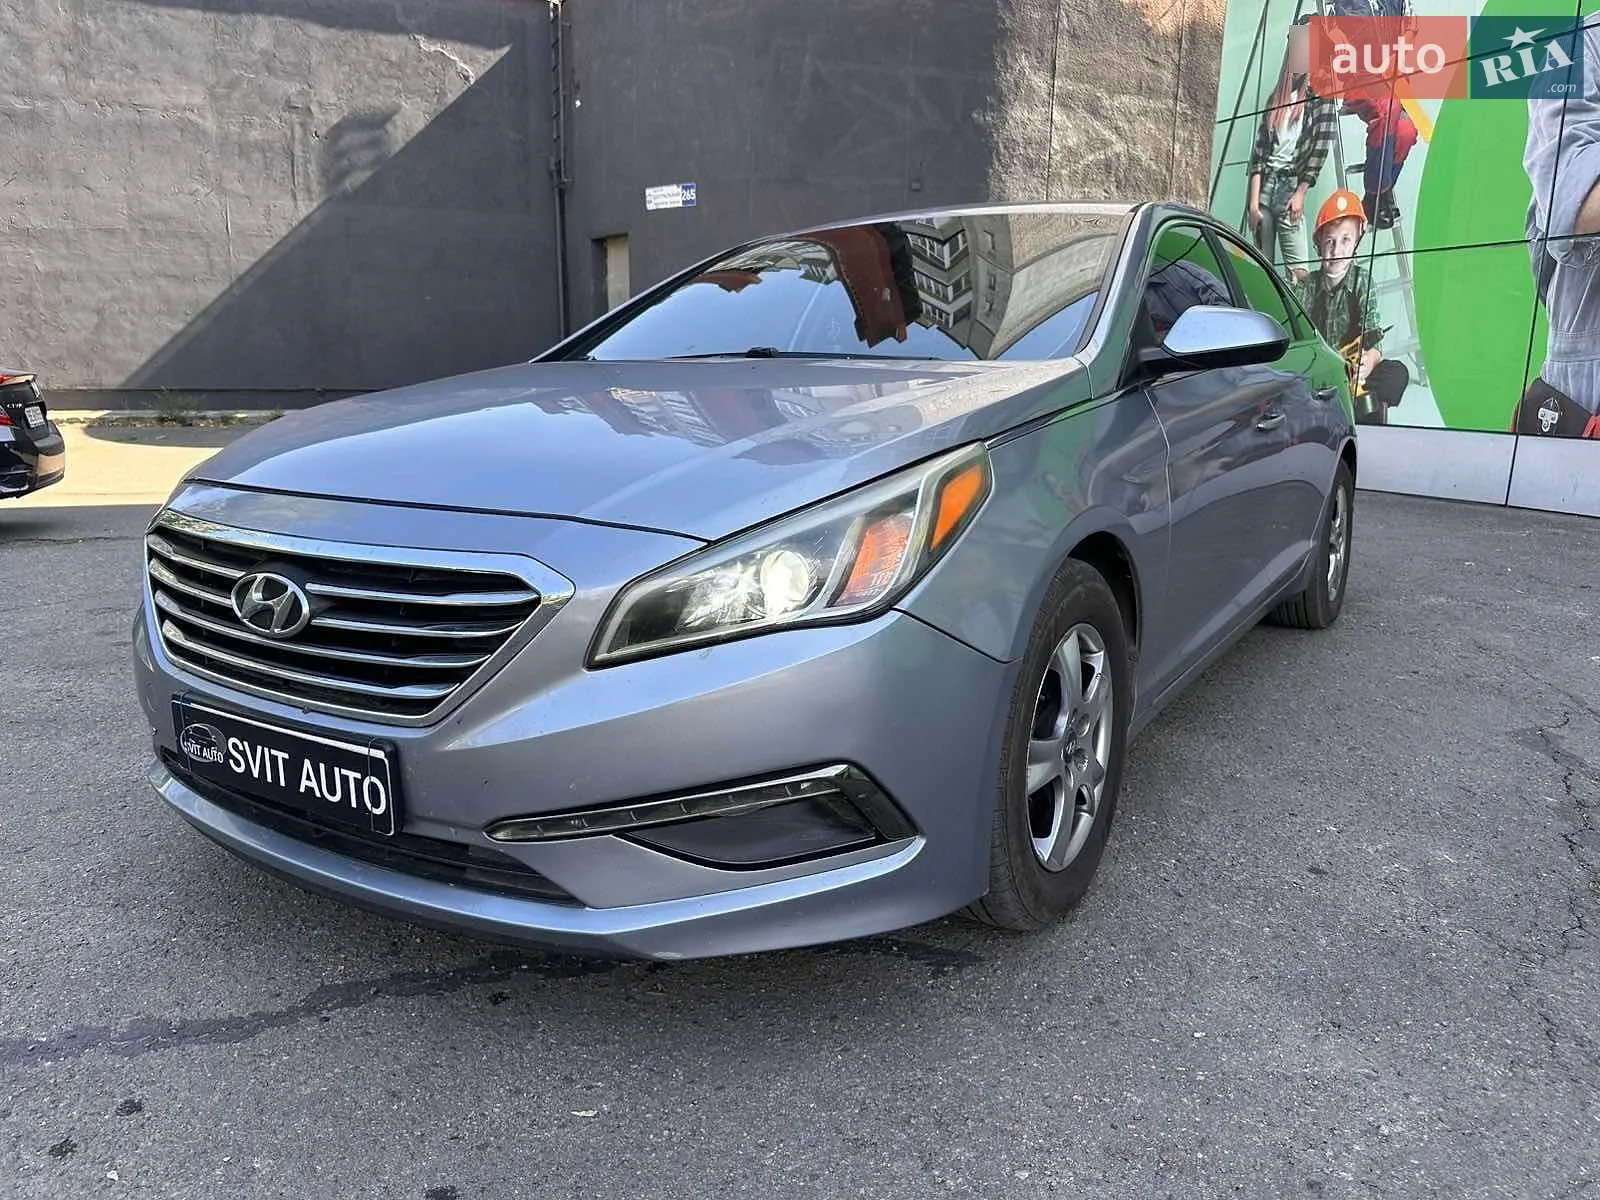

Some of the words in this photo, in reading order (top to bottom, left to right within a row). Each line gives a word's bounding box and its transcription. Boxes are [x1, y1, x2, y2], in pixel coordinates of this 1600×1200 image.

[681, 189, 696, 201] 265
[183, 740, 202, 757] SVIT
[202, 746, 224, 764] AUTO
[227, 737, 290, 788] SVIT
[299, 759, 387, 815] AUTO
